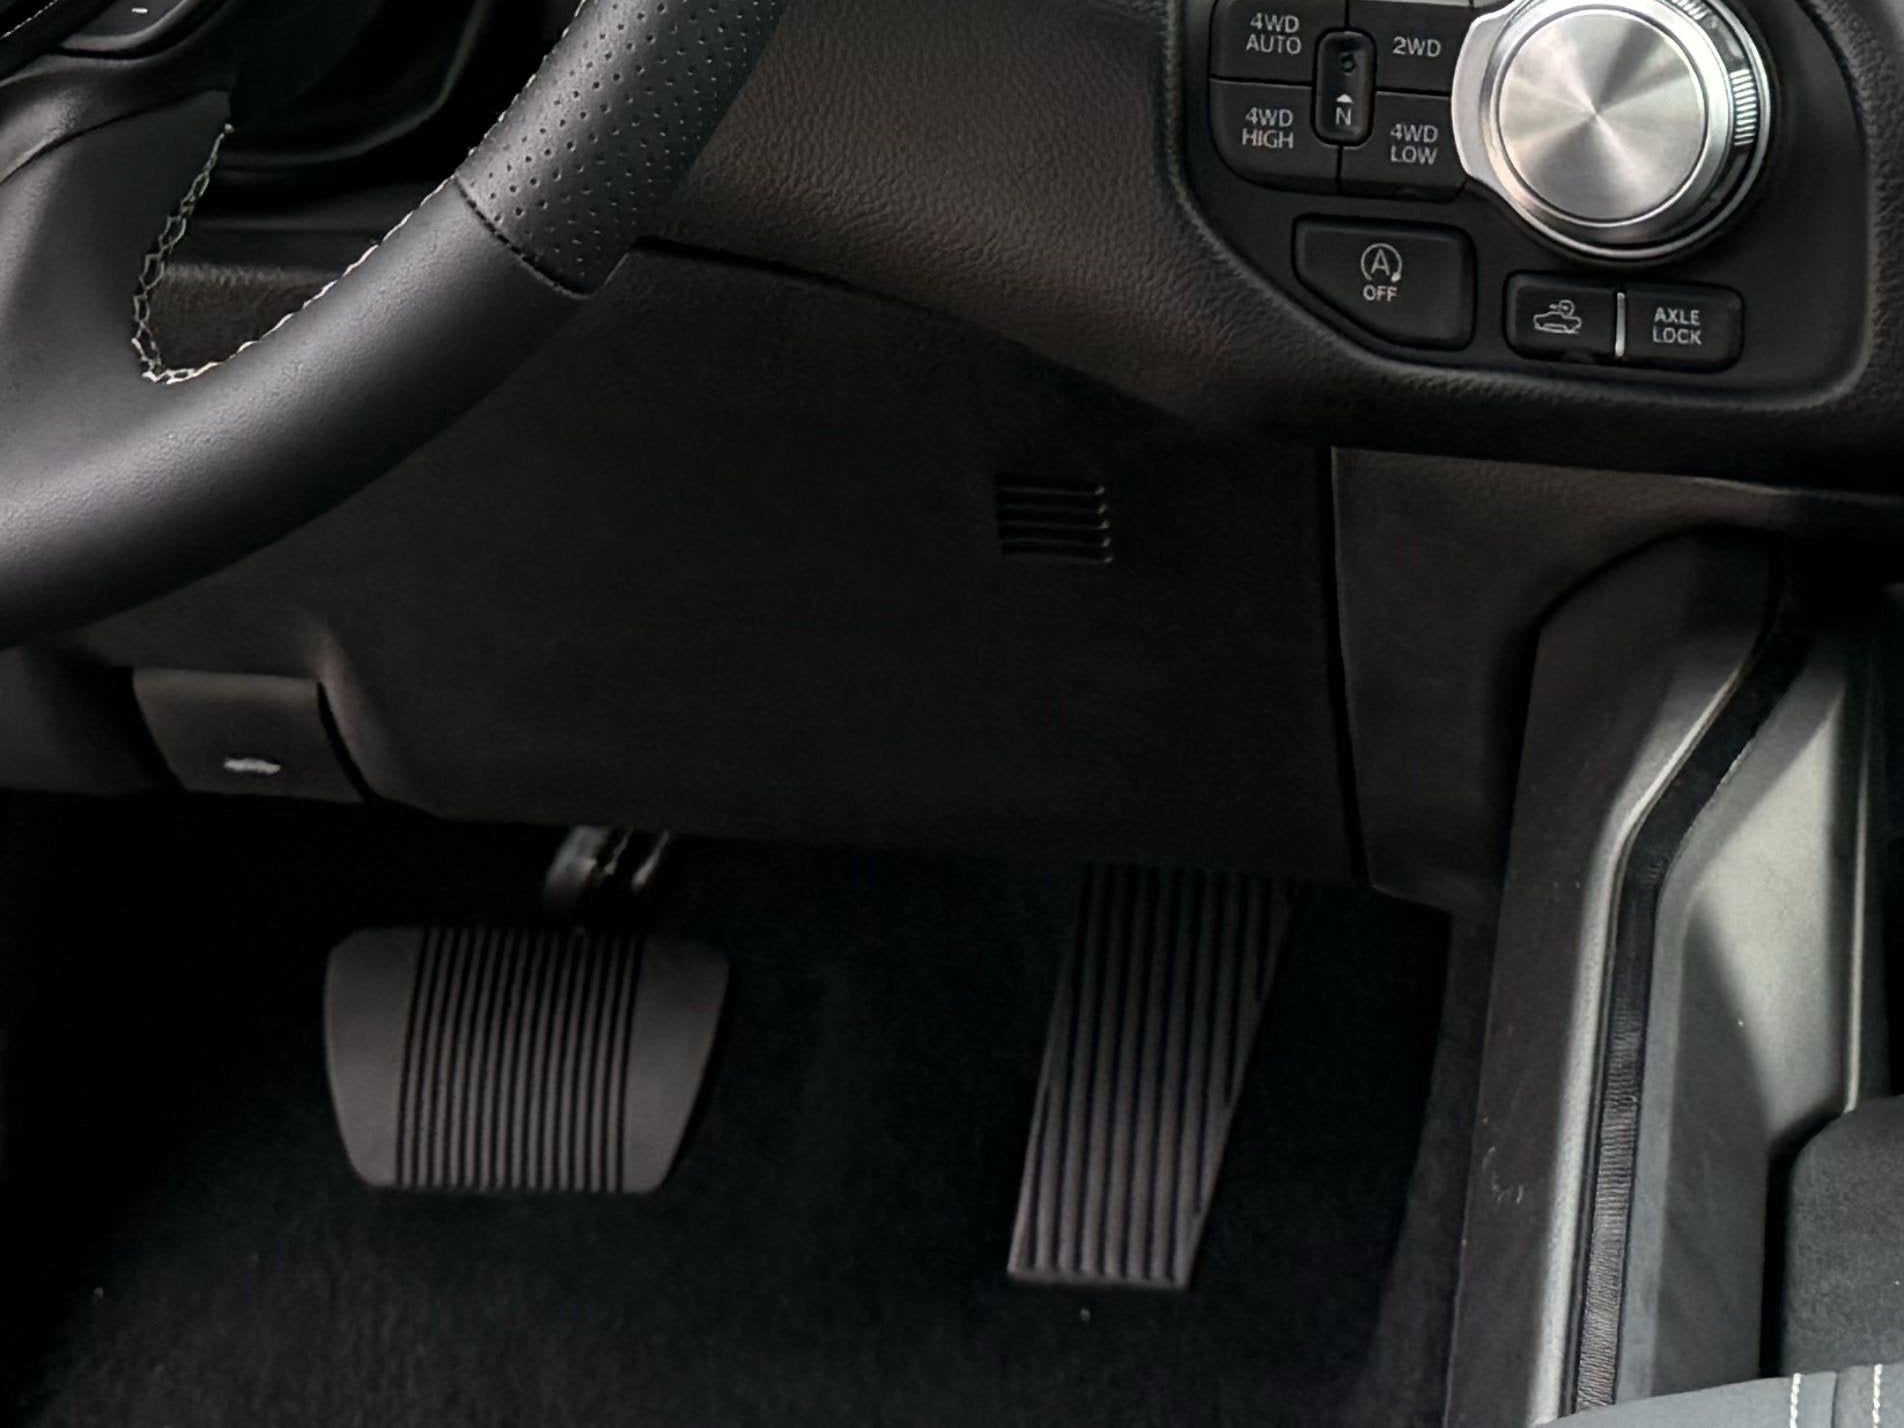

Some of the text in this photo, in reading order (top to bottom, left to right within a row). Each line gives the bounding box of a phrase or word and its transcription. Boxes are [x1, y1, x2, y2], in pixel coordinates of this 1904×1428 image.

[1250, 12, 1299, 34] 4WD
[1245, 33, 1302, 55] AUTO
[1392, 37, 1442, 58] 2WD
[1245, 107, 1294, 128] 4WD
[1336, 109, 1352, 127] N
[1241, 127, 1295, 149] HIGH
[1390, 122, 1439, 144] 4WD
[1390, 144, 1438, 166] LOW
[1362, 284, 1398, 302] OFF
[1653, 307, 1702, 326] AXLE
[1652, 327, 1703, 346] LOCK
